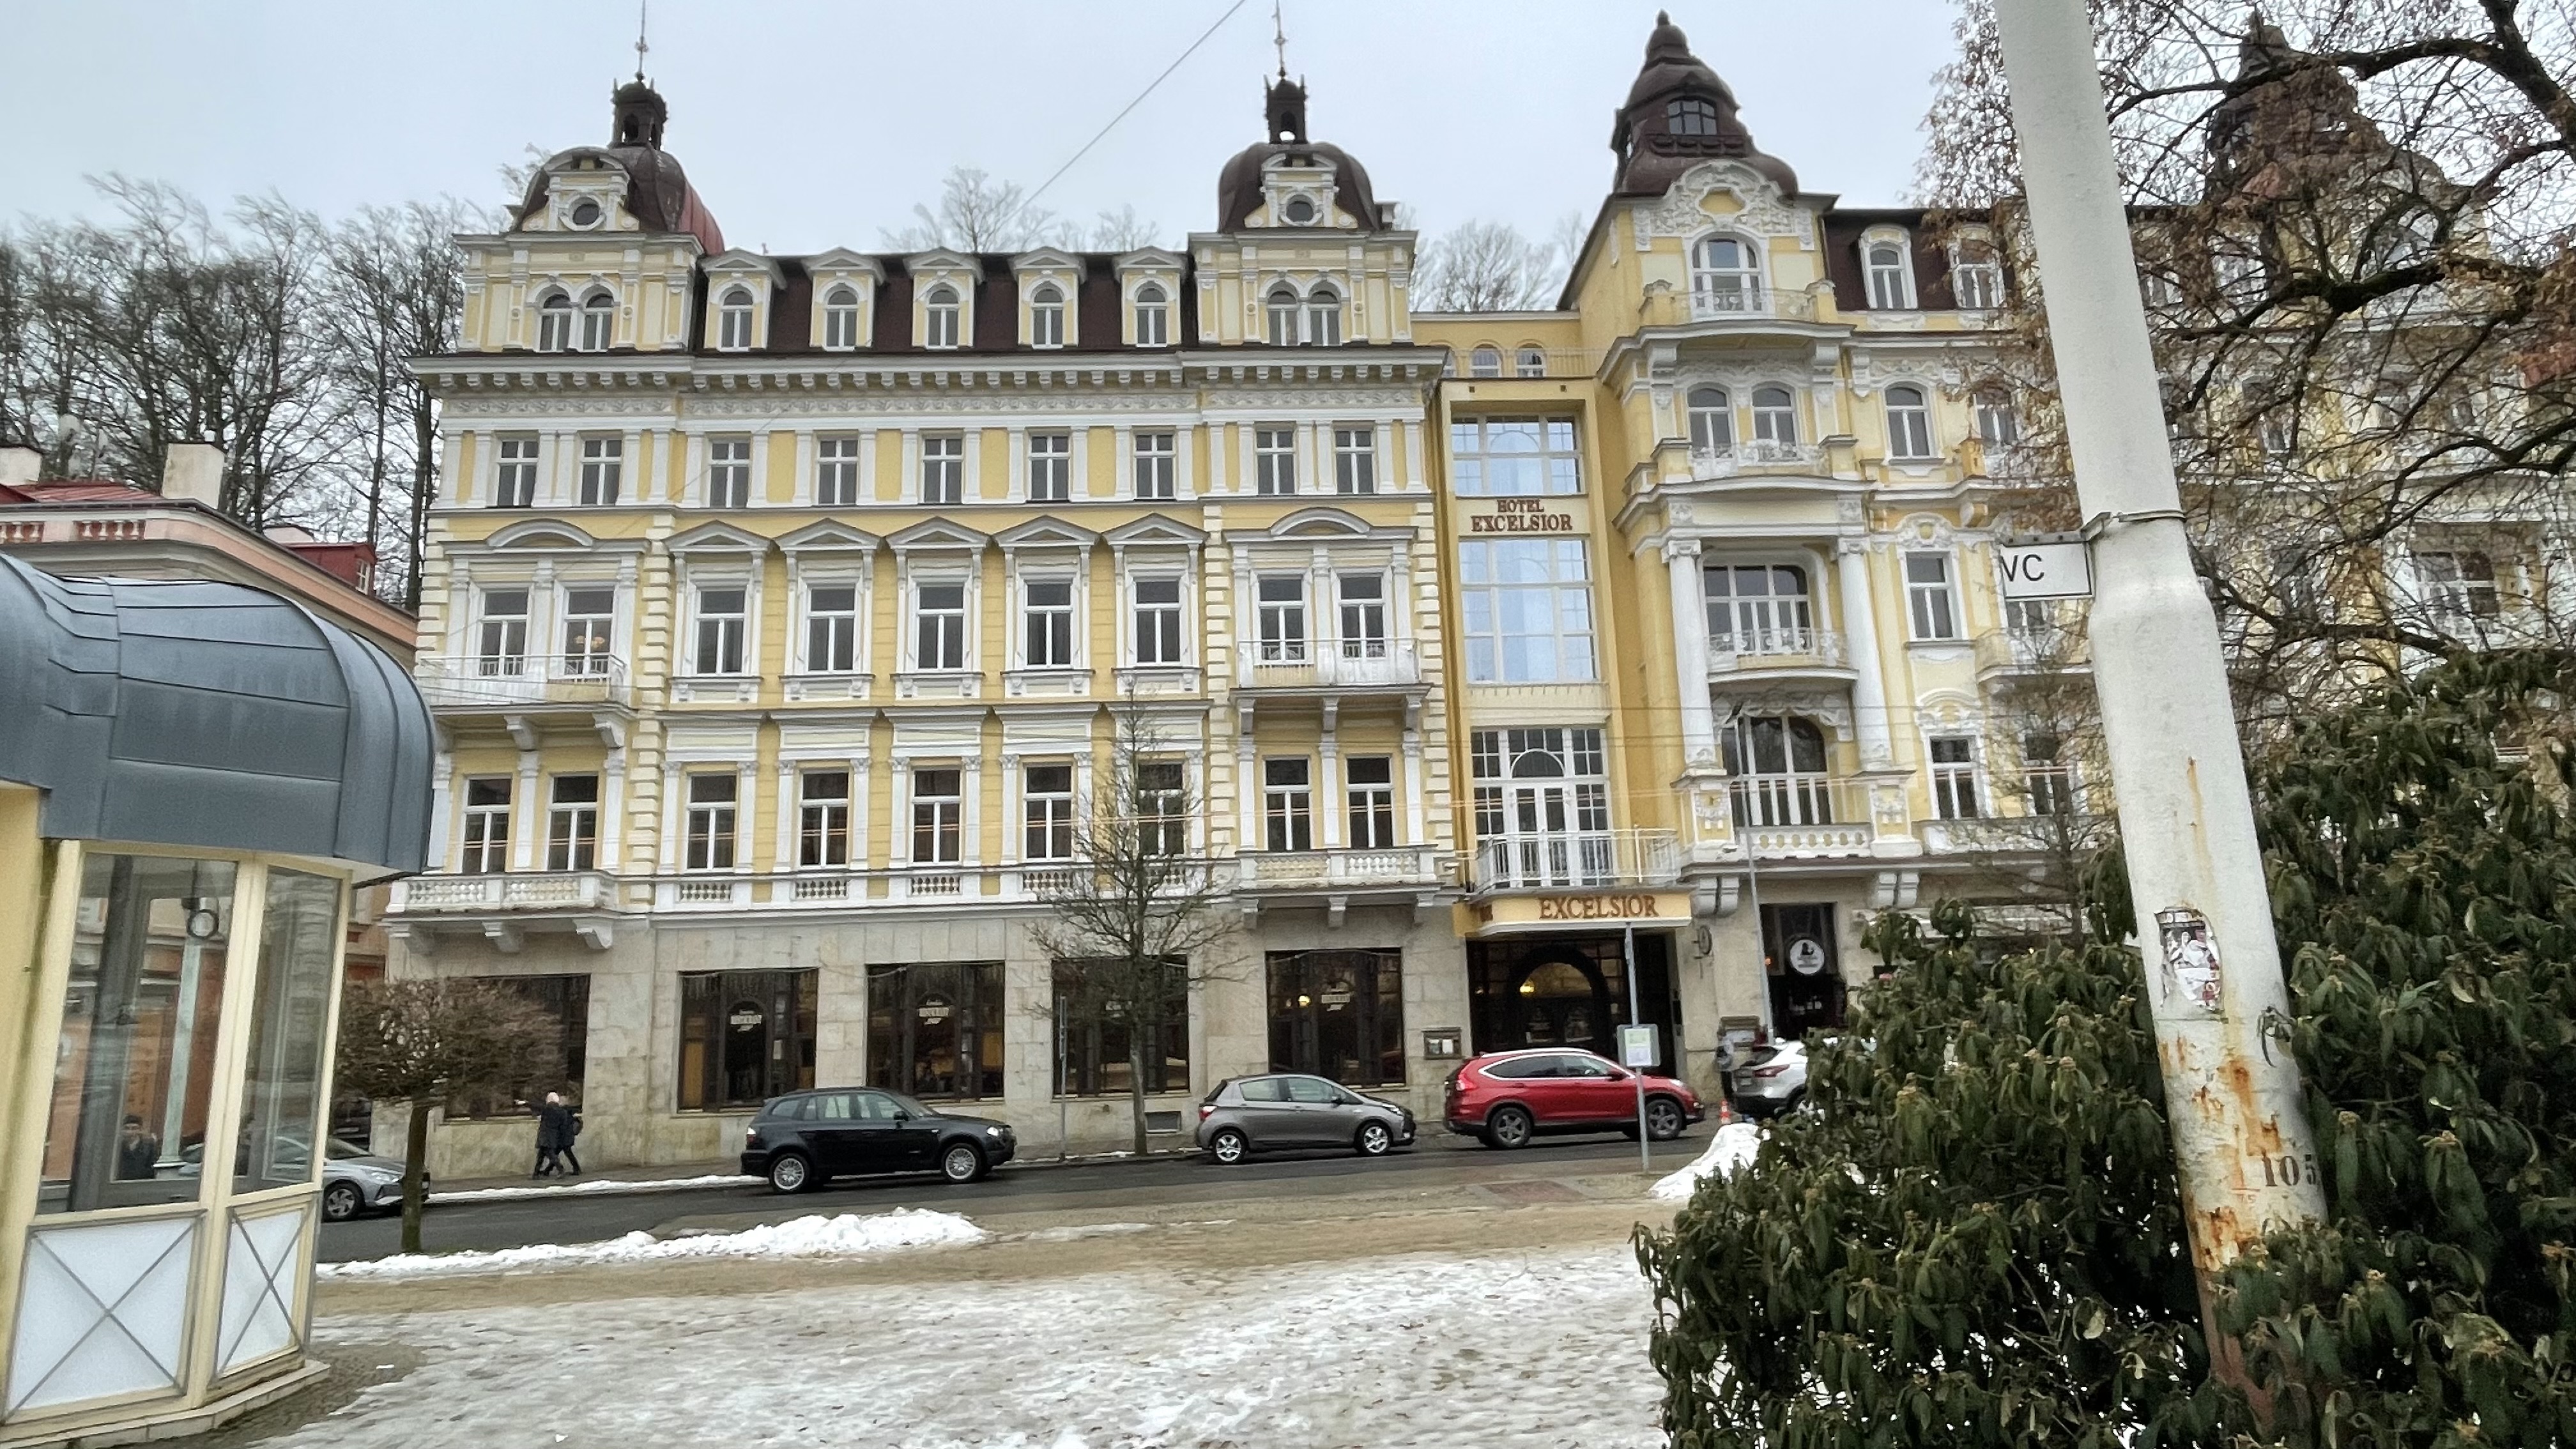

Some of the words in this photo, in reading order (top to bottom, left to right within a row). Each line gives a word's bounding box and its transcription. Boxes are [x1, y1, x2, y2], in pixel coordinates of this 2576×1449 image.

[1497, 498, 1545, 513] HOTEL
[1471, 514, 1573, 532] EXCELSIOR
[1539, 895, 1660, 920] EXCELSIOR
